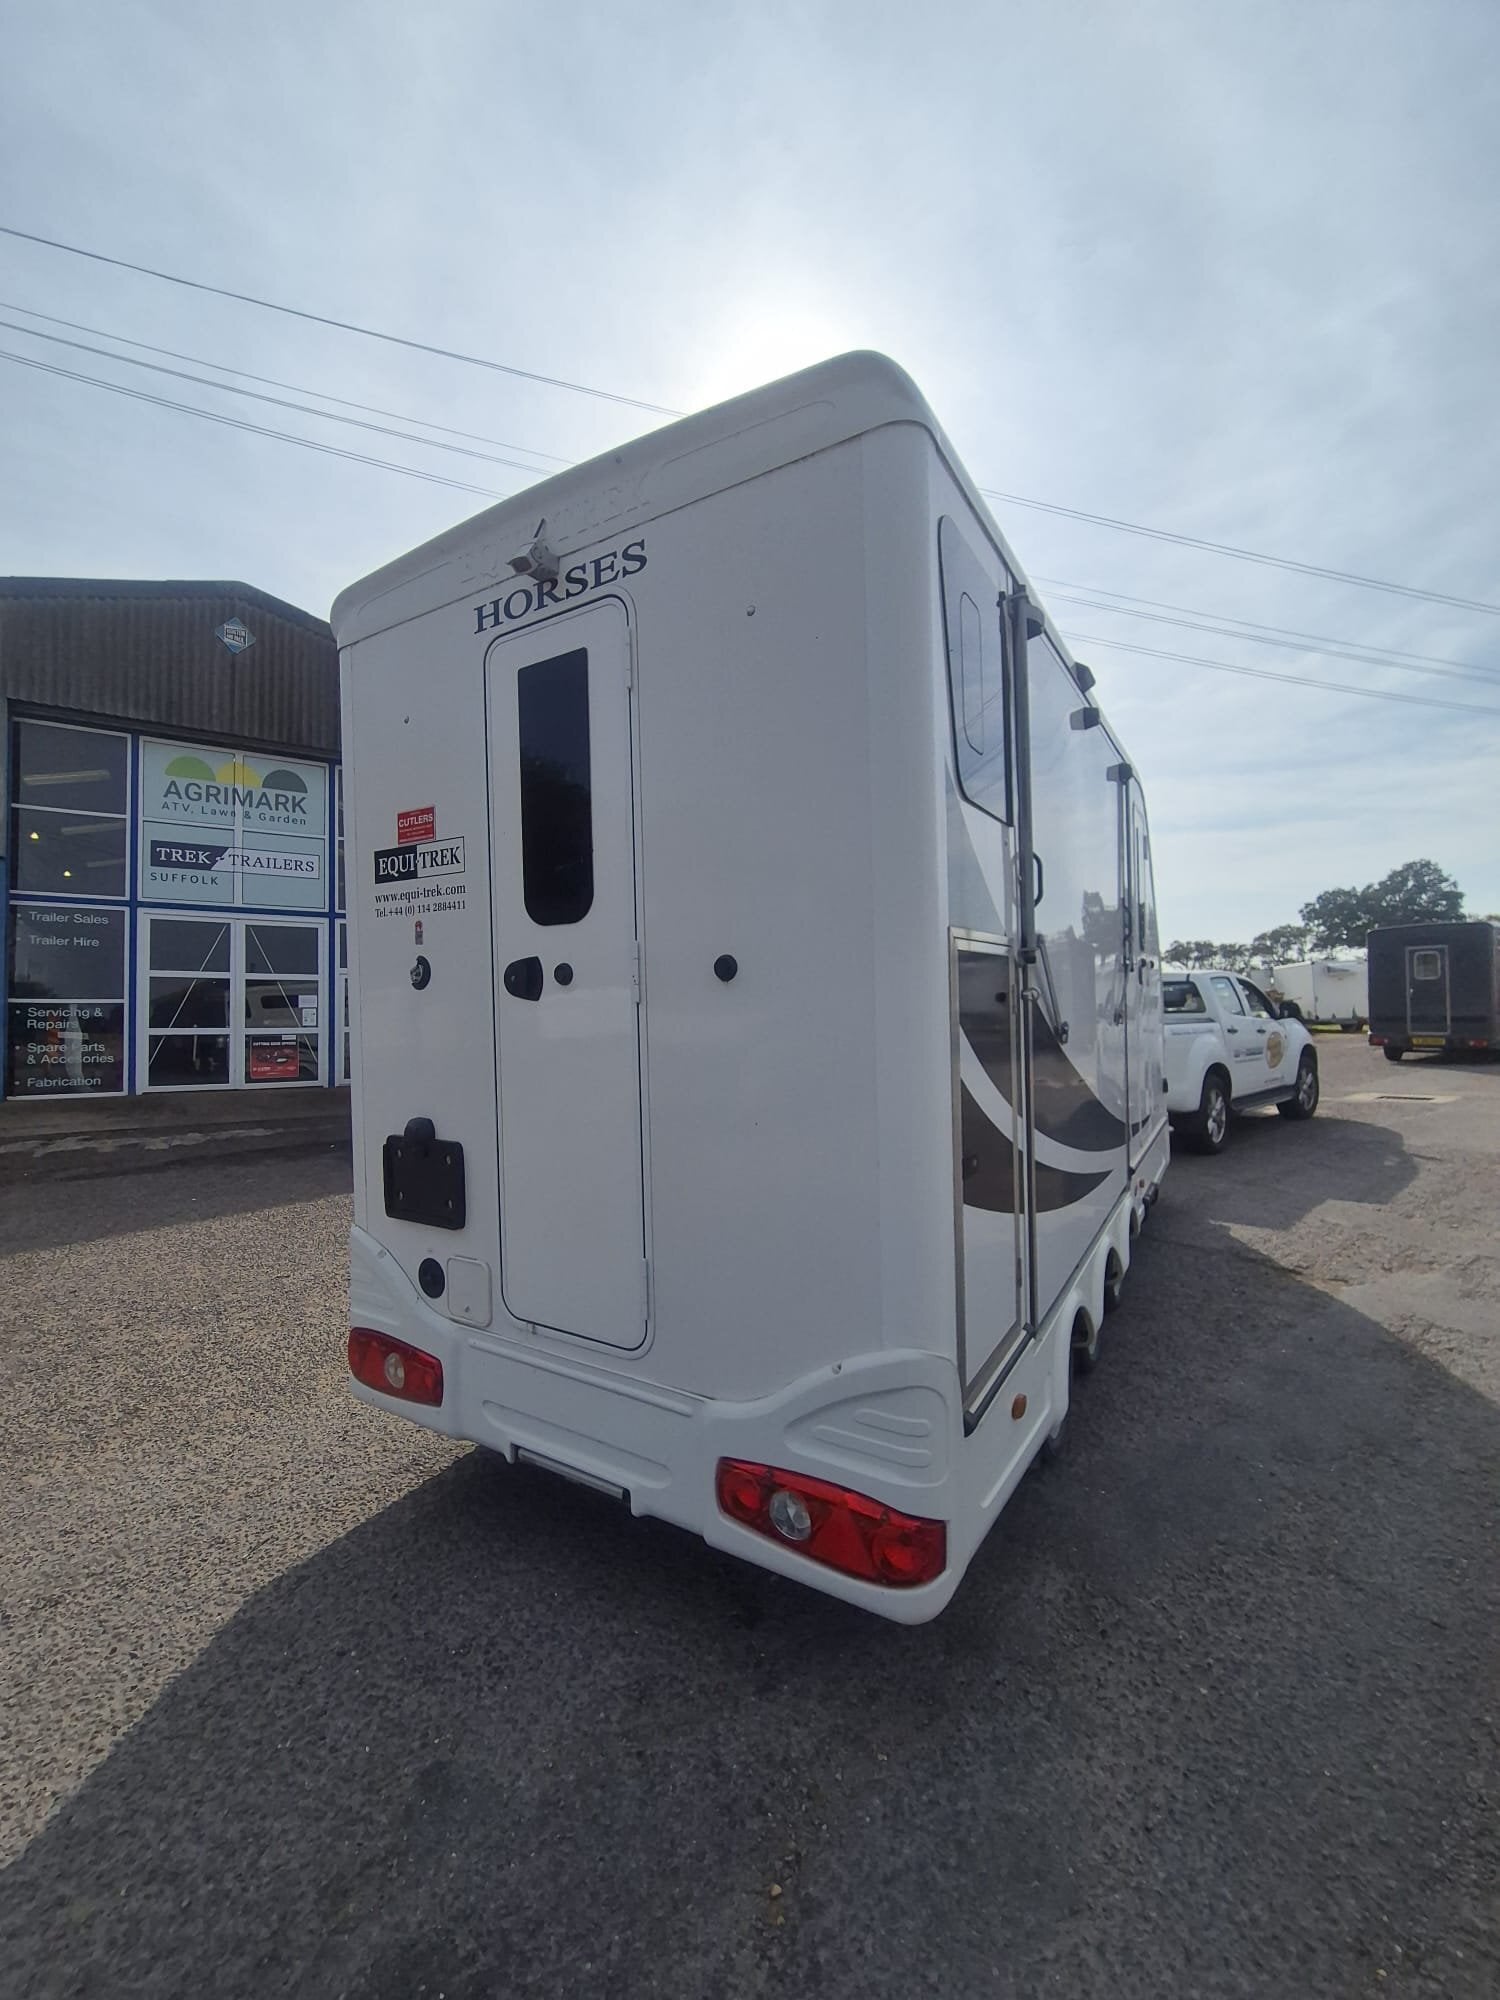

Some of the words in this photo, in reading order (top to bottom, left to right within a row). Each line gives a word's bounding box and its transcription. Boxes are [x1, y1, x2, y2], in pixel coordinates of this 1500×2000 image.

[474, 539, 648, 634] HORSES
[163, 780, 307, 814] AGRIMARK
[245, 810, 252, 819] &
[258, 812, 306, 825] Garden
[399, 813, 433, 828] CUTLERS
[157, 847, 212, 864] TREK
[228, 854, 315, 872] TRAILERS
[150, 872, 218, 885] SUFFOLK
[375, 884, 466, 903] www.equi-trek.com
[405, 904, 415, 917] (0)
[417, 903, 431, 913] 114
[29, 911, 70, 923] Trailer
[73, 913, 109, 924] Sales
[29, 935, 70, 946] Trailer
[73, 937, 100, 947] Hire
[27, 1007, 90, 1019] Servicing
[94, 1007, 103, 1017] &
[26, 1019, 79, 1030] Repairs
[27, 1042, 67, 1054] Spare
[26, 1054, 36, 1065] &
[27, 1077, 101, 1088] Fabrication
